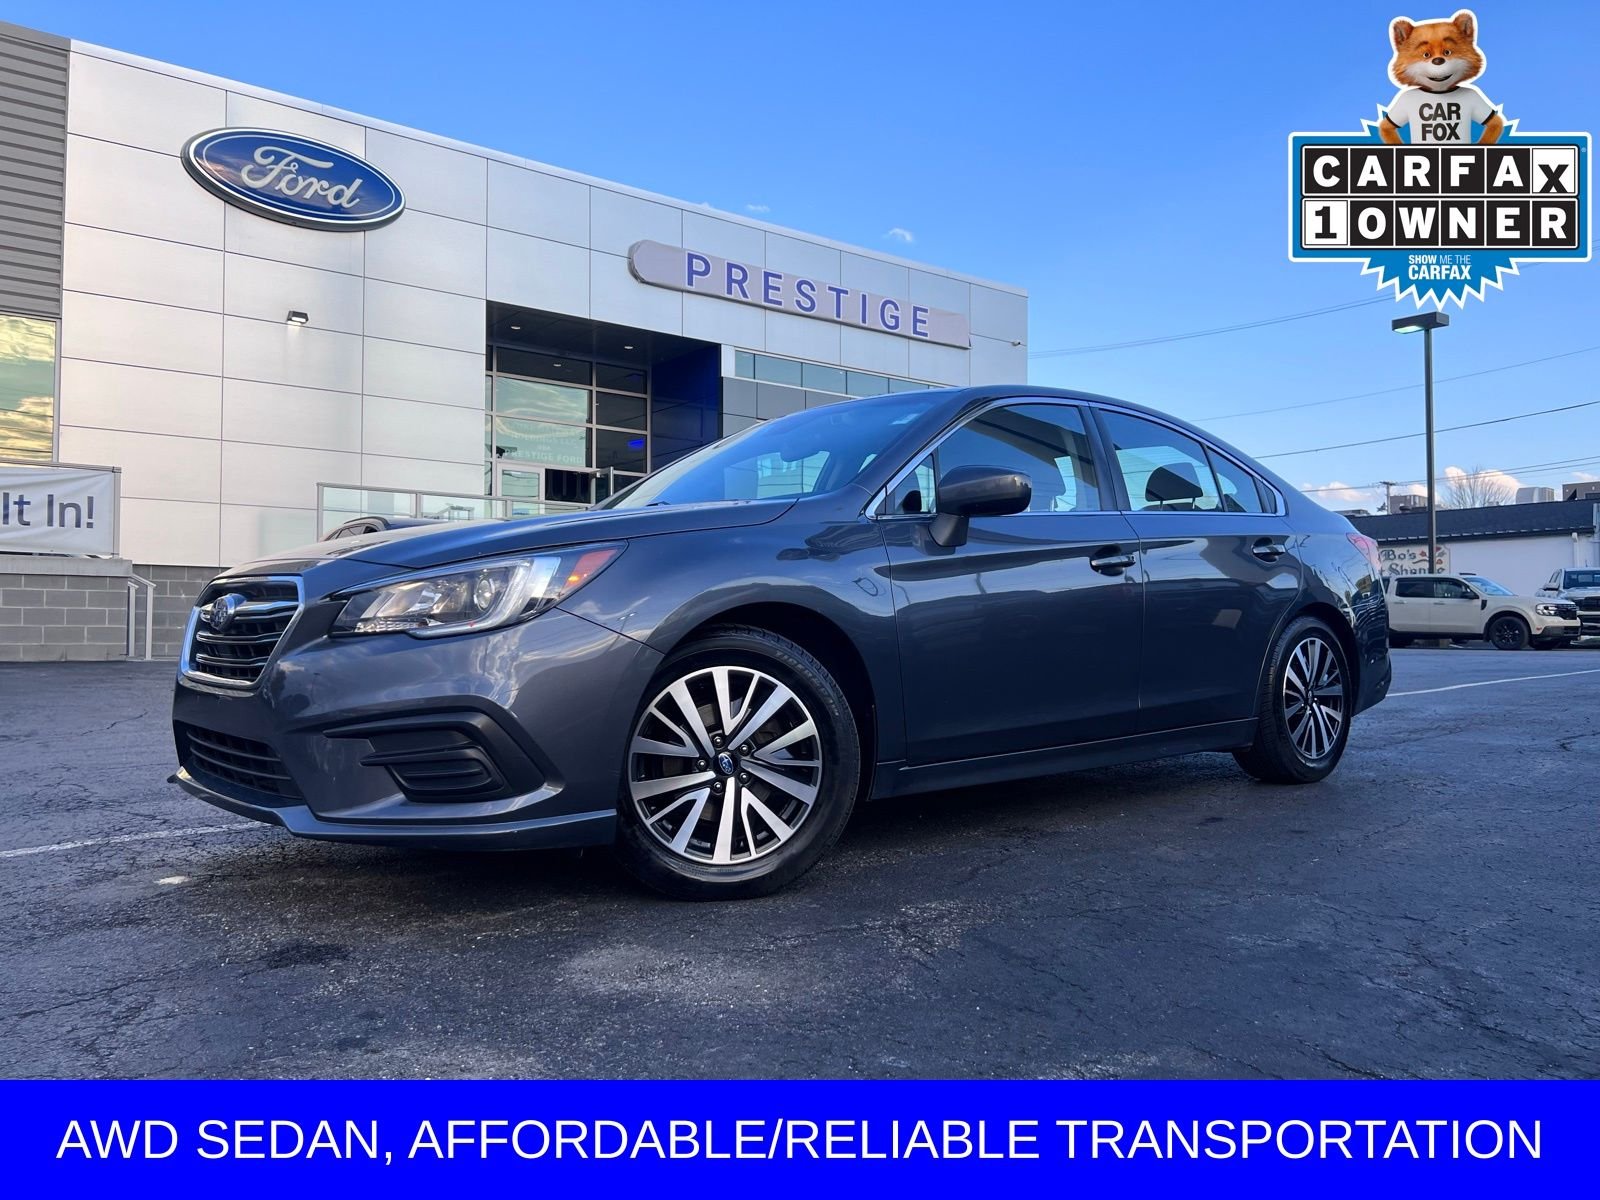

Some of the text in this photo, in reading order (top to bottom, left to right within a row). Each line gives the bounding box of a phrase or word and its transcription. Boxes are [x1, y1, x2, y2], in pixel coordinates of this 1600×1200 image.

[240, 145, 363, 209] Ford
[686, 251, 930, 338] PRESTIGE
[2, 491, 94, 529] It In!
[1381, 548, 1417, 561] Bo's
